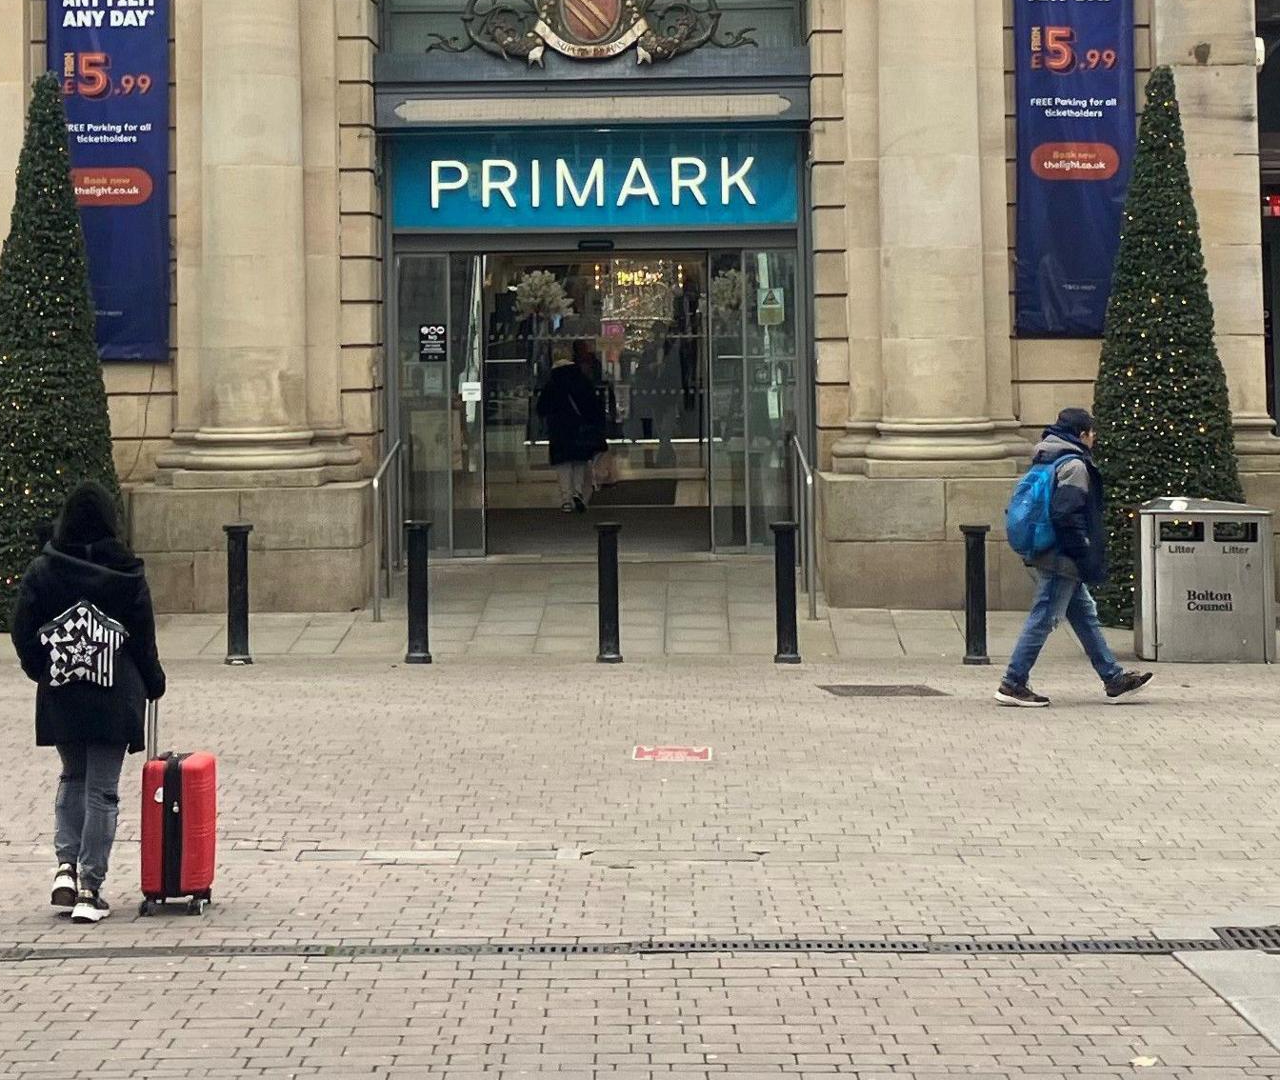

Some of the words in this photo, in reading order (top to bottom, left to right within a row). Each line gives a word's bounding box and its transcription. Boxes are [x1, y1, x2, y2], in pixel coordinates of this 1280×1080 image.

[62, 10, 105, 27] ANY
[1030, 97, 1053, 106] FREE
[1054, 97, 1088, 109] Parking
[1089, 97, 1104, 106] for
[1105, 97, 1117, 106] all
[1044, 108, 1103, 117] ticketholders
[87, 123, 122, 134] Parking
[124, 123, 138, 132] for
[140, 123, 152, 131] all
[76, 134, 137, 143] ticketholders
[430, 155, 757, 209] PRIMARK
[1168, 545, 1196, 554] Litter
[1222, 545, 1250, 555] Litter
[1186, 589, 1233, 601] Bolton
[1186, 601, 1233, 612] Council
